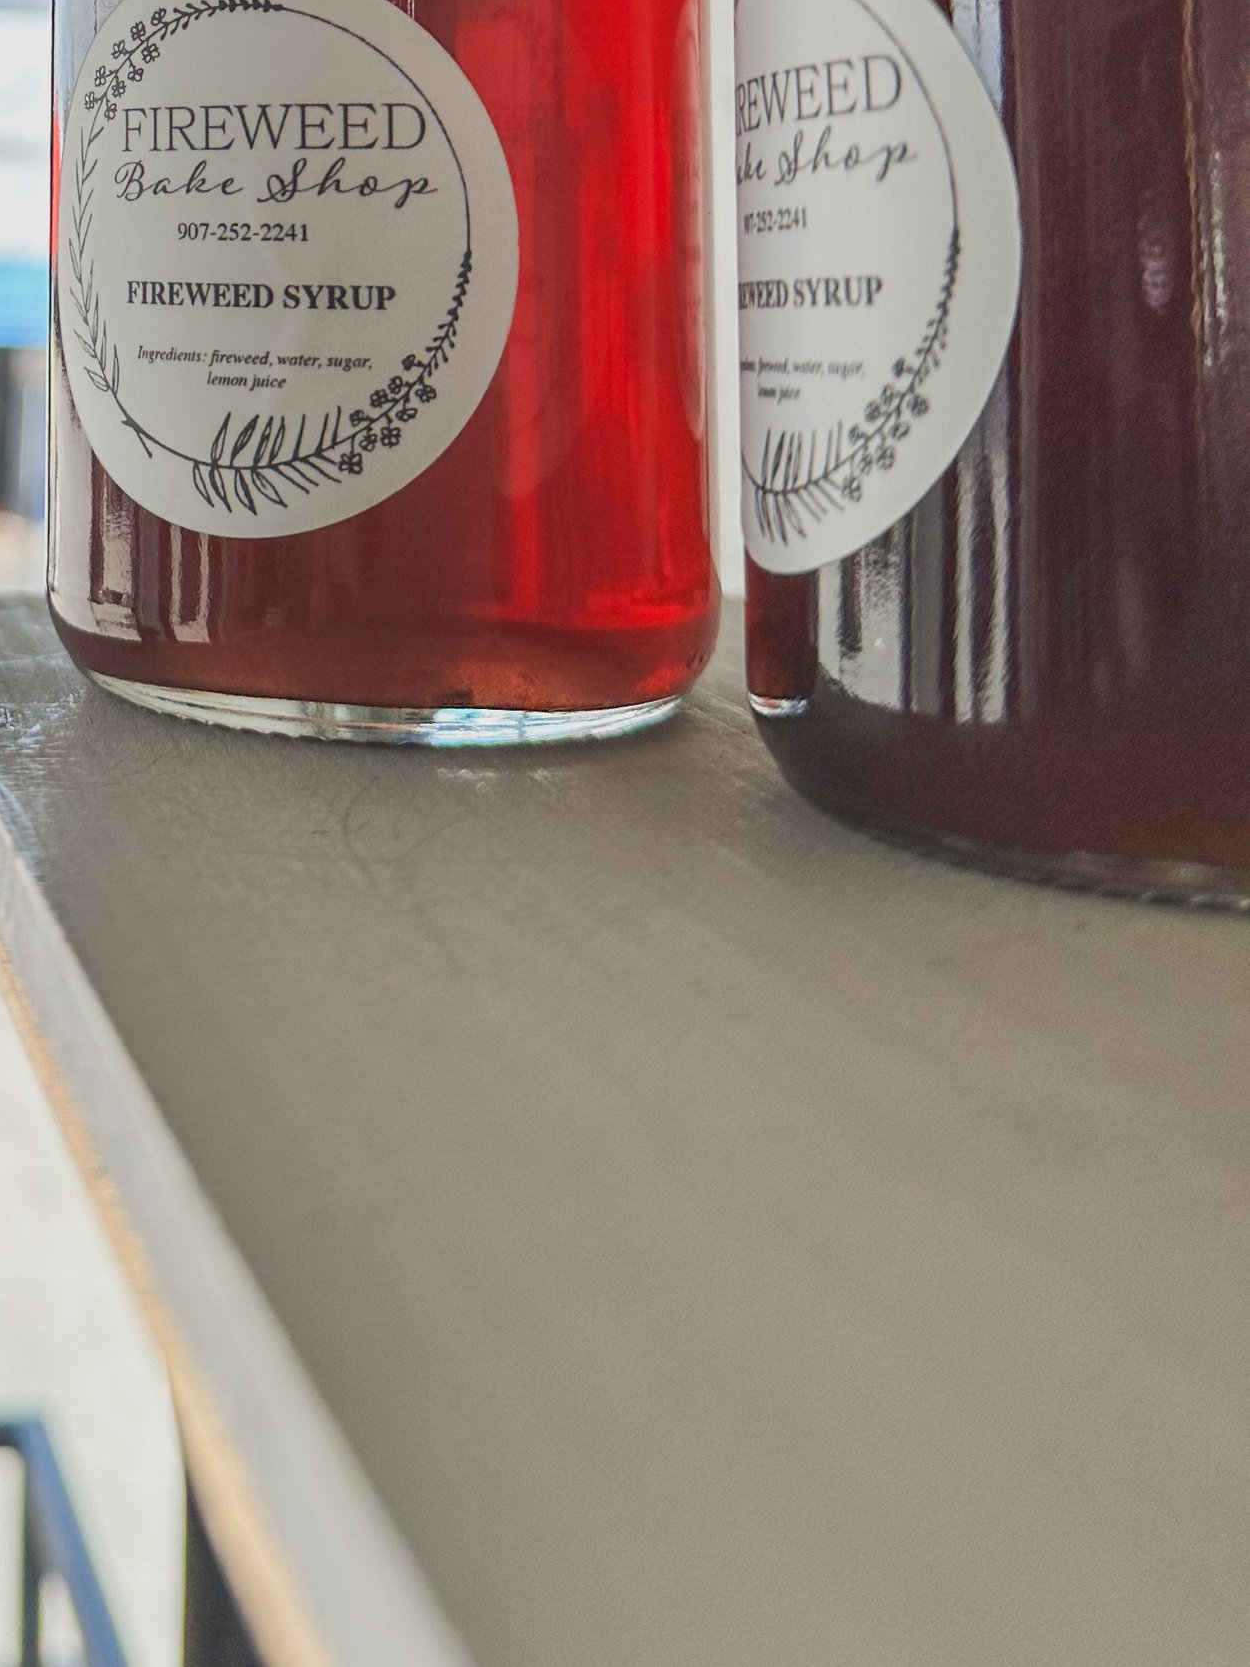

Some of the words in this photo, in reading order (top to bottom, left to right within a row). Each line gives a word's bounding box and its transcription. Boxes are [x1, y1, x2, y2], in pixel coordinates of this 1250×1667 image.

[121, 102, 428, 152] FIREWEED
[773, 124, 918, 184] Shop
[114, 159, 244, 202] Bake
[256, 156, 439, 209] Shop
[177, 222, 309, 242] 907-252-2241
[126, 280, 274, 309] FIREWEED
[282, 284, 396, 311] SYRUP
[792, 275, 883, 308] SYRUP
[137, 345, 207, 364] Ingredients:
[207, 348, 274, 368] fireweed,
[276, 354, 322, 370] water,
[325, 355, 373, 372] sugar,
[206, 370, 248, 388] lemon
[249, 372, 287, 392] juice
